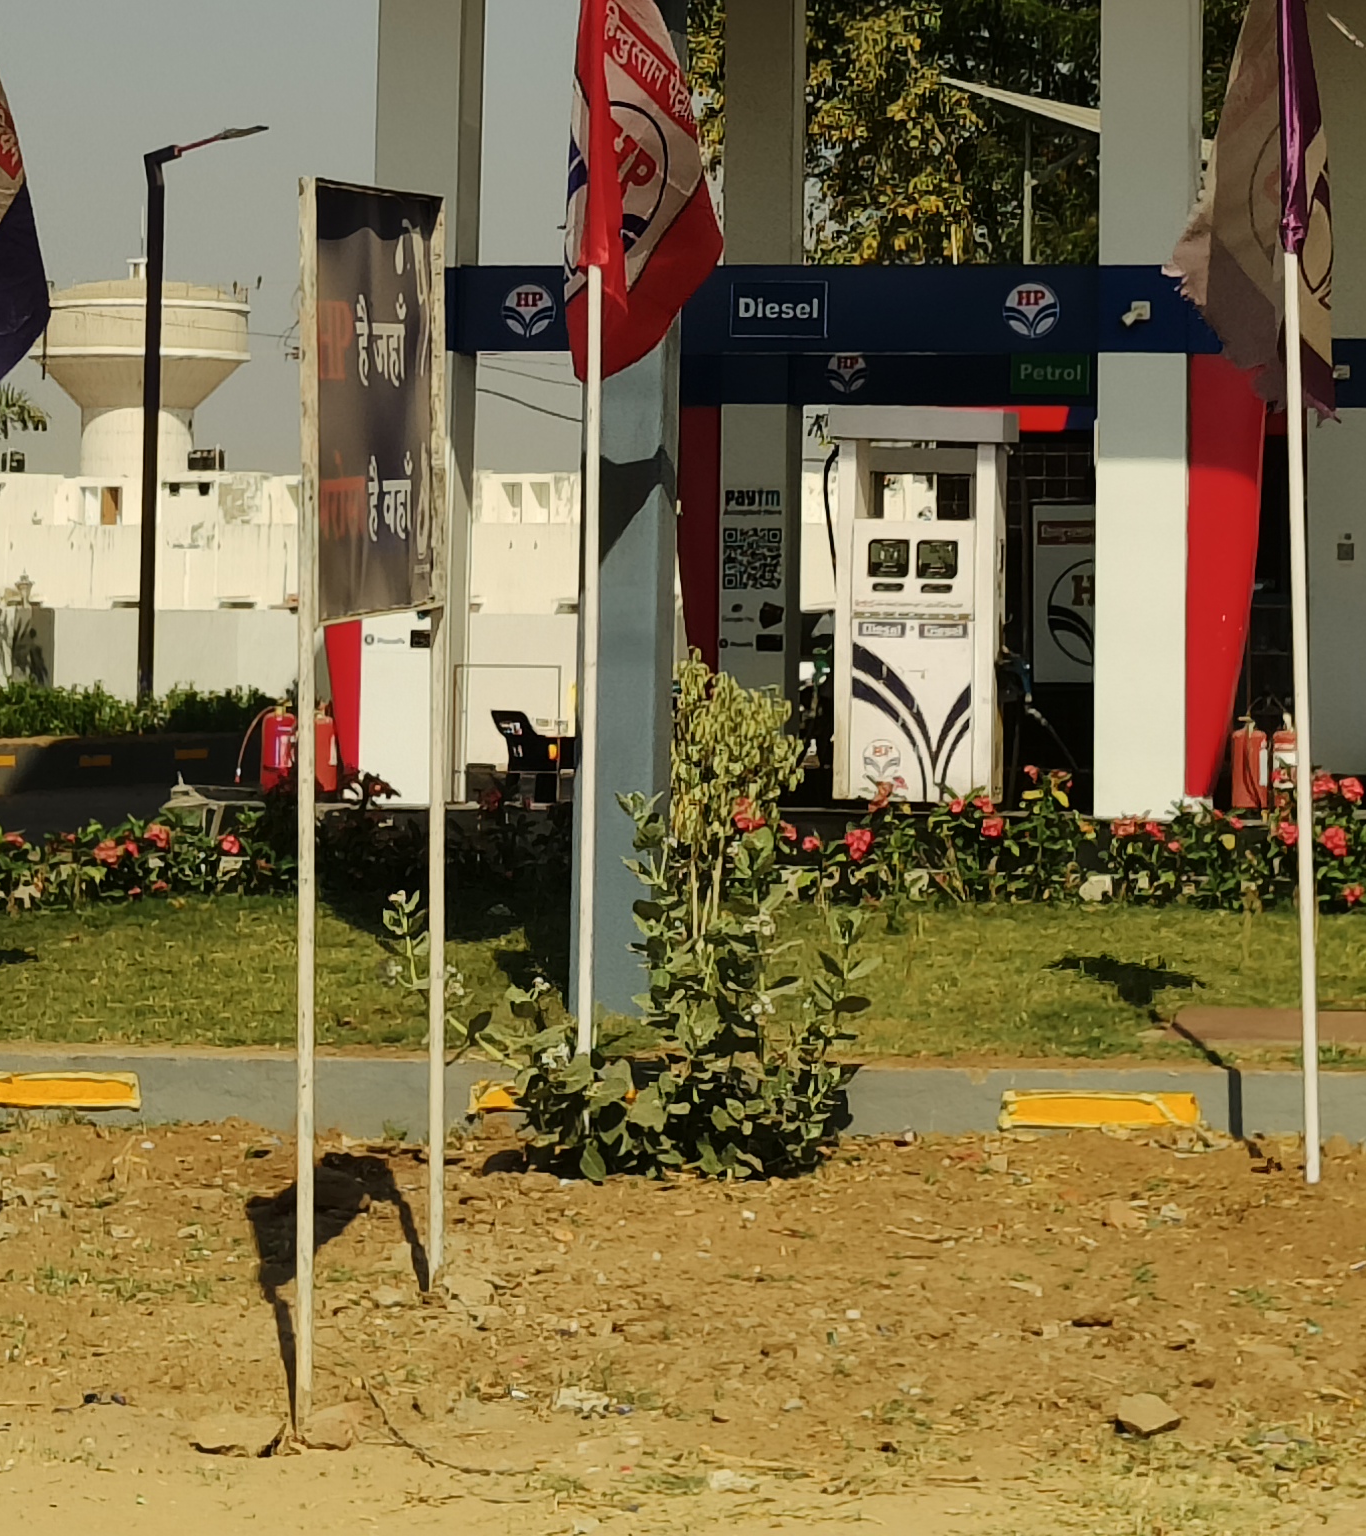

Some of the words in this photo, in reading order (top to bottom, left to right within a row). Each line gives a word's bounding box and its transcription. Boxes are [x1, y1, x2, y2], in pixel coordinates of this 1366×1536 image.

[515, 291, 545, 308] HP
[738, 296, 820, 320] Diesel
[1016, 291, 1046, 308] HP
[355, 294, 370, 388] है
[836, 355, 861, 371] HP
[1019, 362, 1083, 383] Petrol
[367, 454, 380, 542] है
